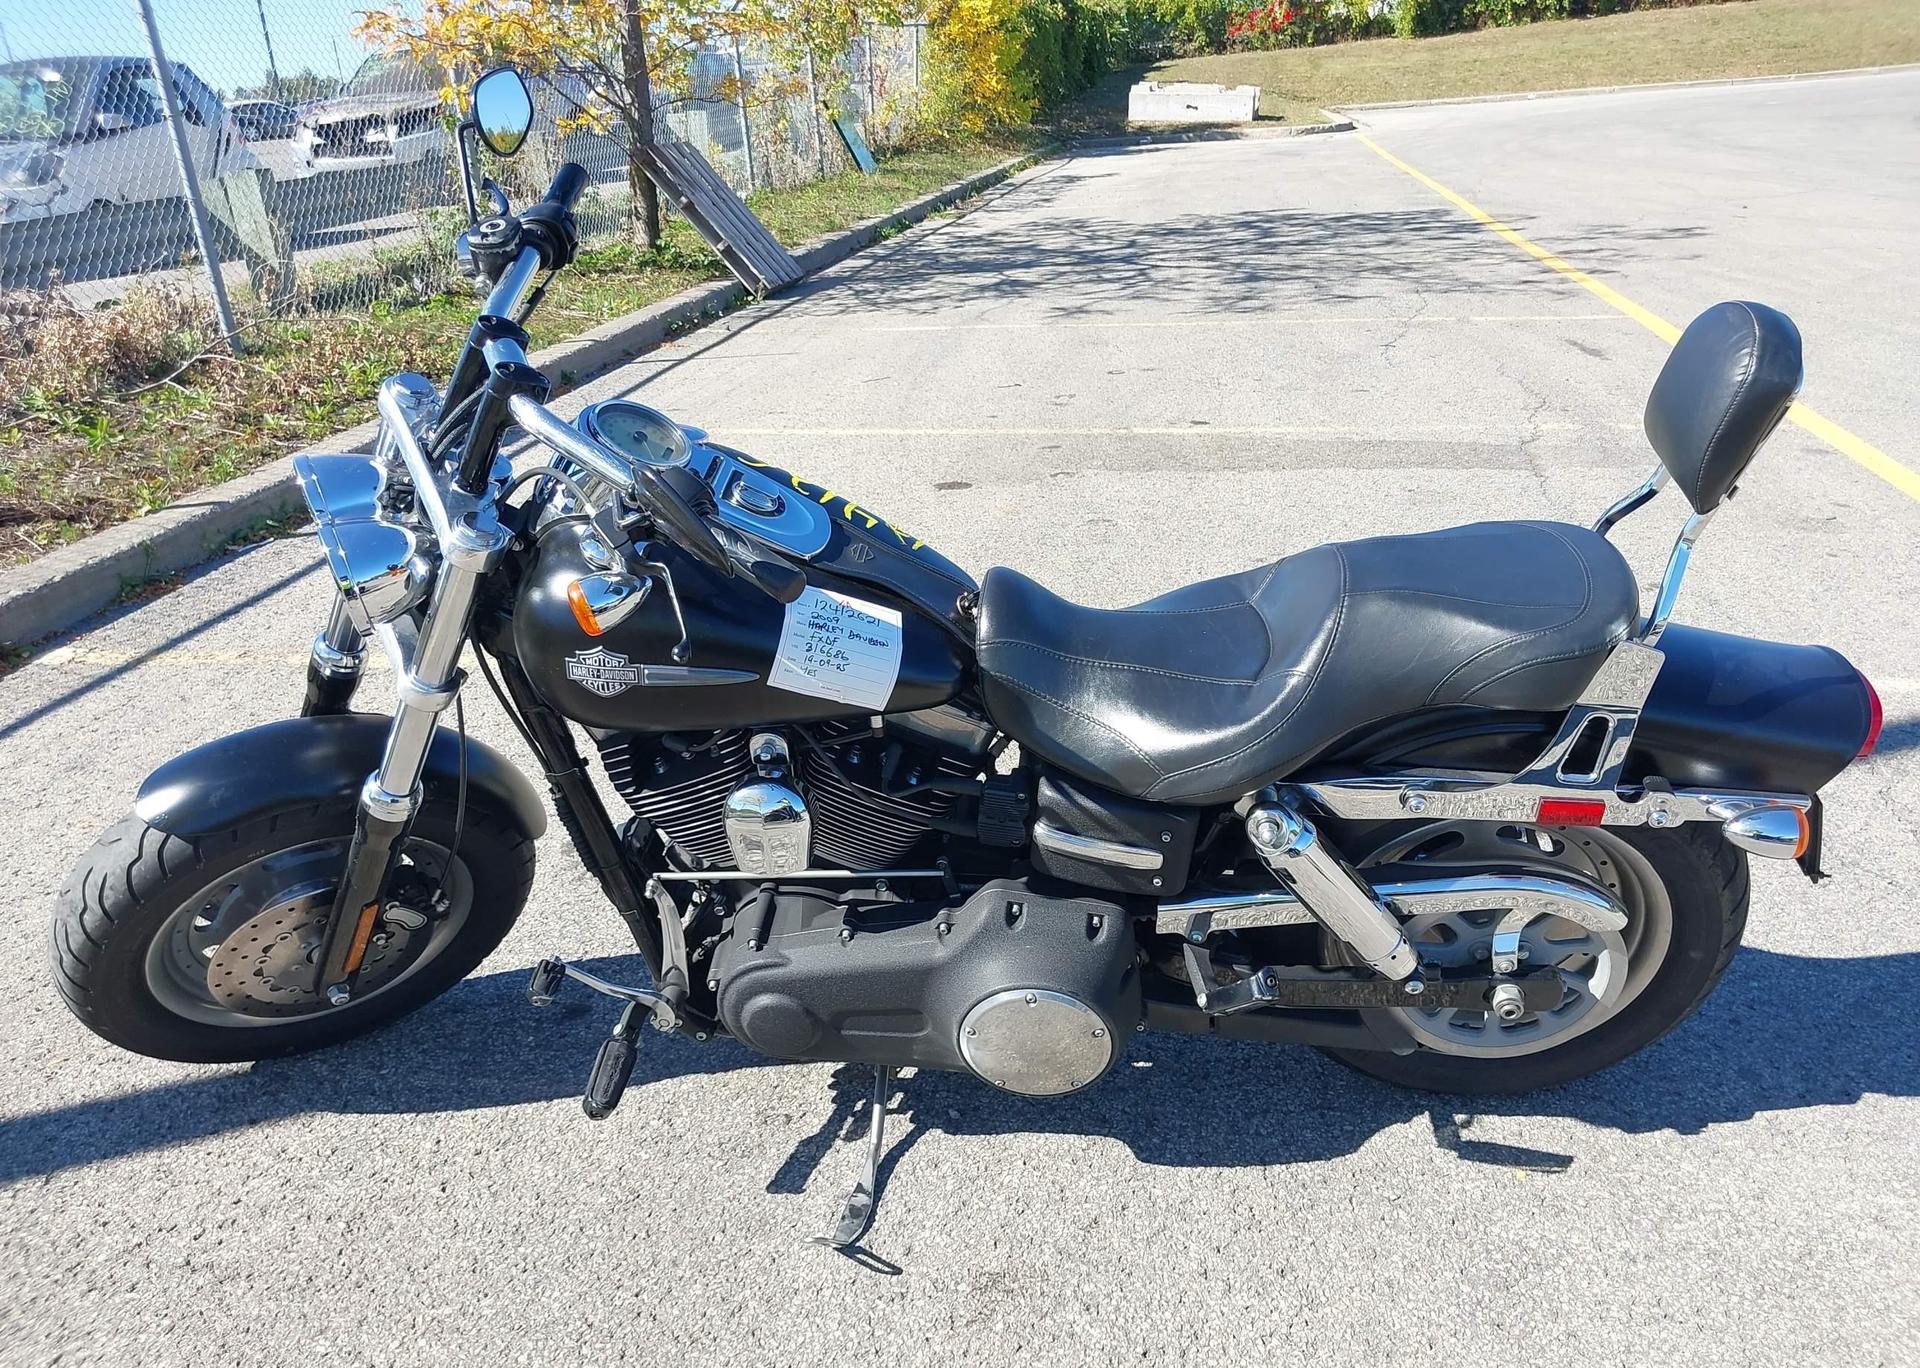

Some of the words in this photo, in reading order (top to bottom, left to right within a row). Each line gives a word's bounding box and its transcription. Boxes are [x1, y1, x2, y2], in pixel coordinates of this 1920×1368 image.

[811, 612, 840, 624] 2009
[808, 620, 844, 634] HARLEY
[585, 656, 619, 667] MOTOR
[572, 666, 635, 681] HARLEY-DAVIDSON
[587, 680, 621, 693] CYCLES
